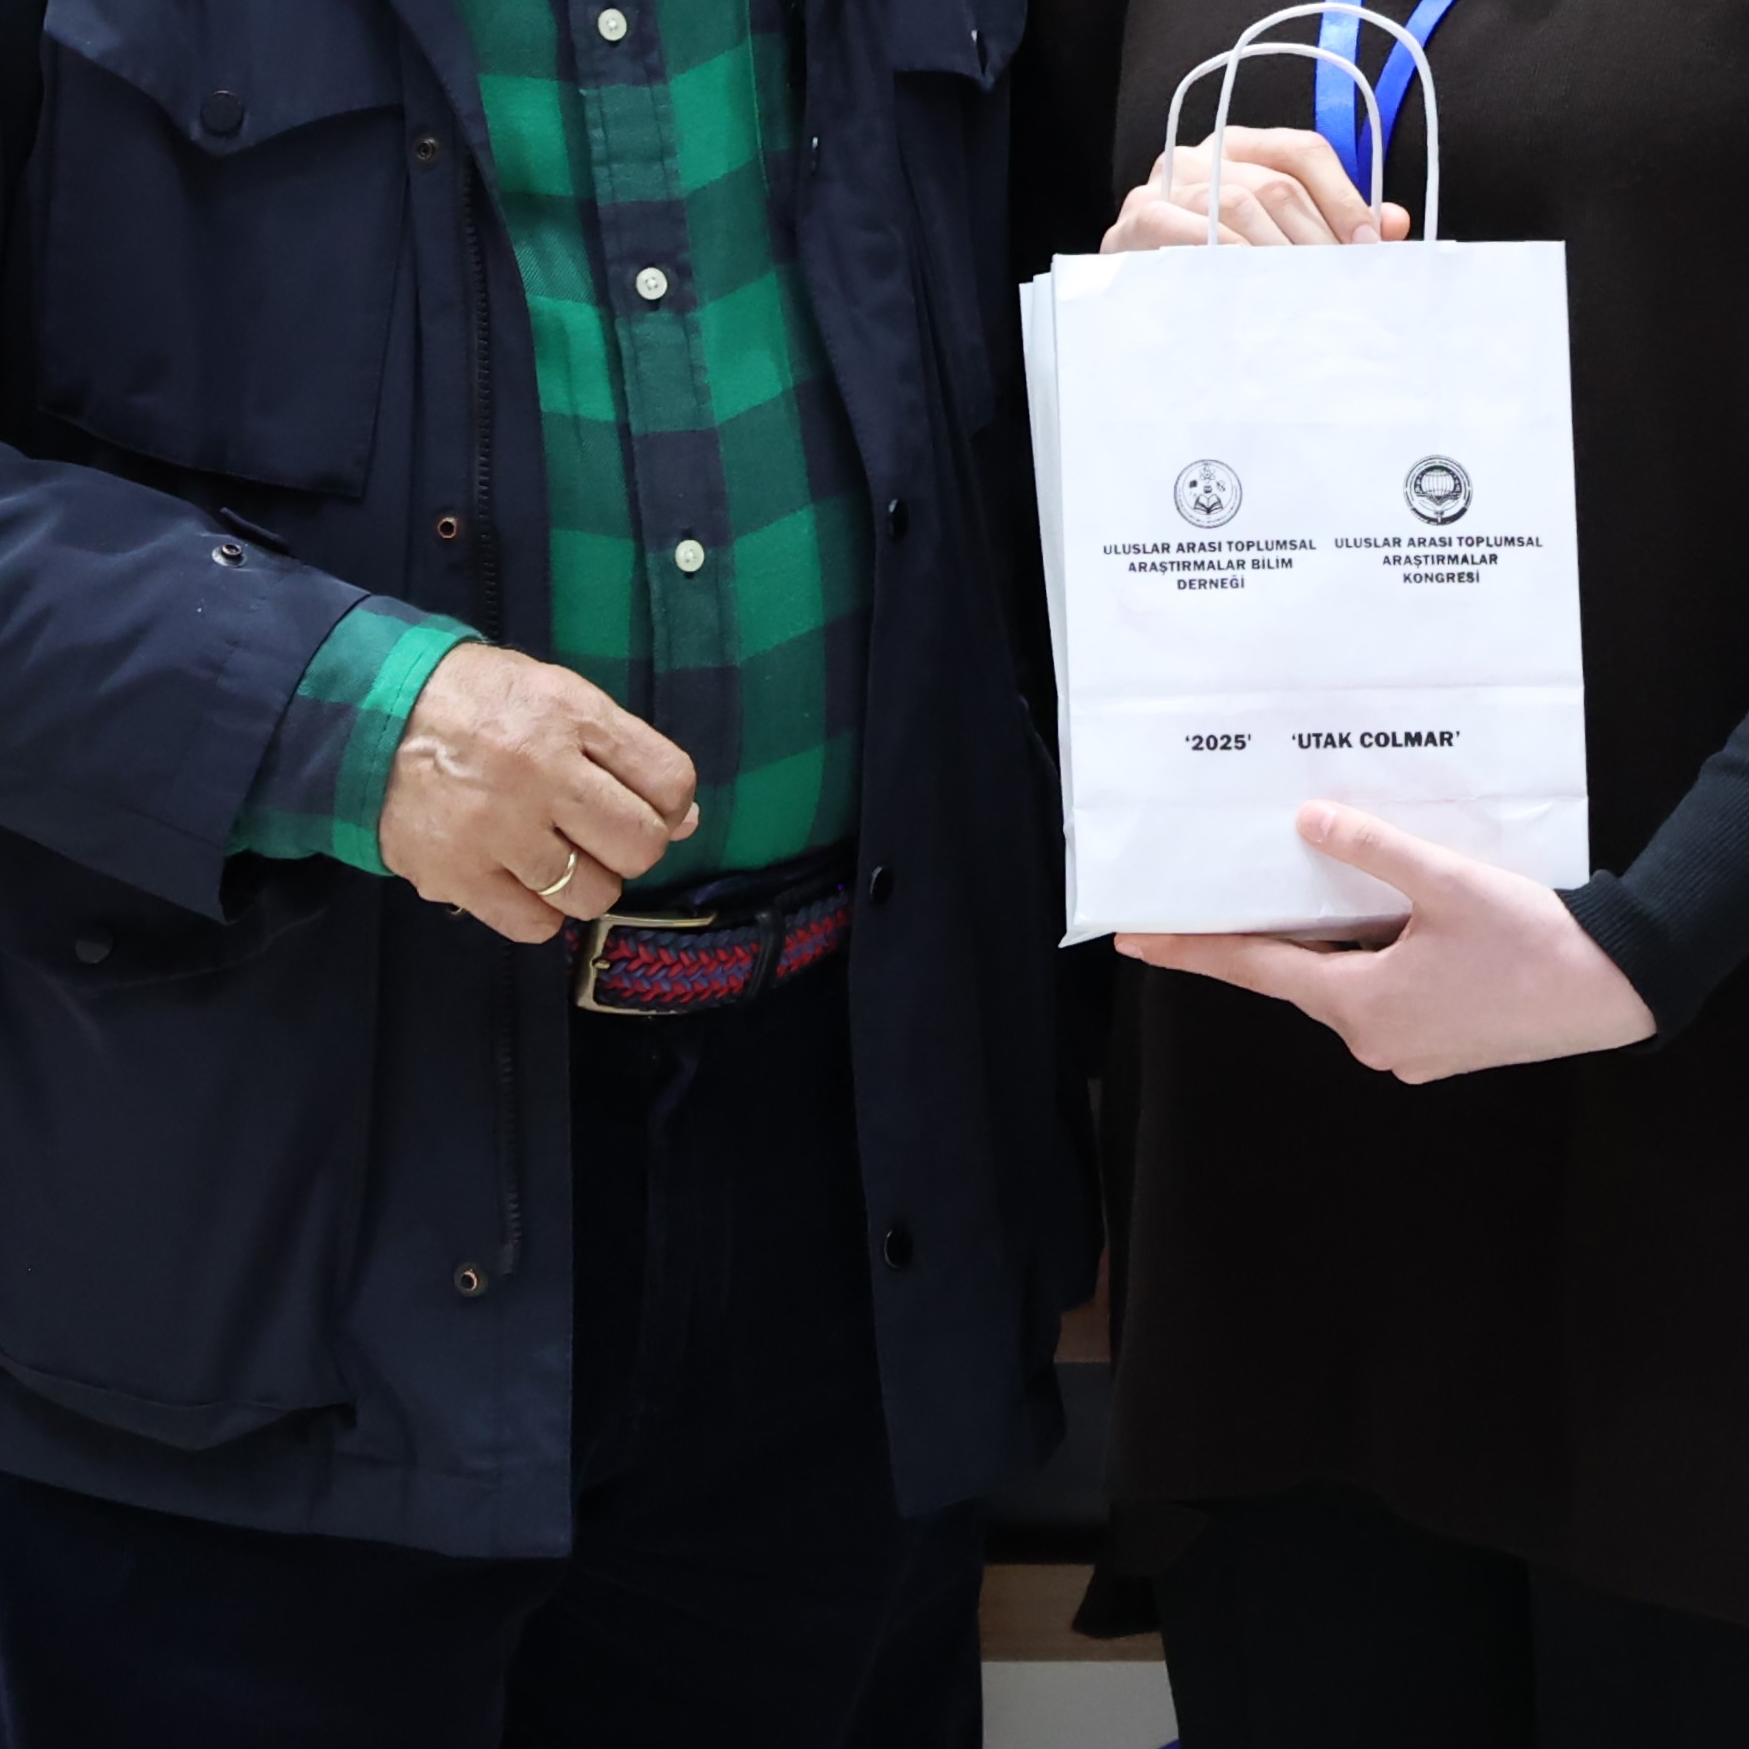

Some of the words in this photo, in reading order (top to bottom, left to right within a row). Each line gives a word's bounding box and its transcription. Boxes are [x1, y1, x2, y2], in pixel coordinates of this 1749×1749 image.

[1103, 542, 1171, 555] ULUSLAR
[1176, 541, 1222, 554] ARASI
[1226, 539, 1316, 552] TOPLUMSAL
[1335, 537, 1402, 549] ULUSLAR
[1407, 536, 1452, 548] ARASI
[1456, 536, 1543, 548] TOPLUMSAL
[1128, 559, 1246, 576] ARAŞTIRMALAR
[1251, 555, 1293, 570] BİLİM
[1383, 553, 1498, 568] ARAŞTIRMALAR
[1177, 573, 1245, 590] DERNEĞİ
[1403, 570, 1481, 584] KONGRESİ
